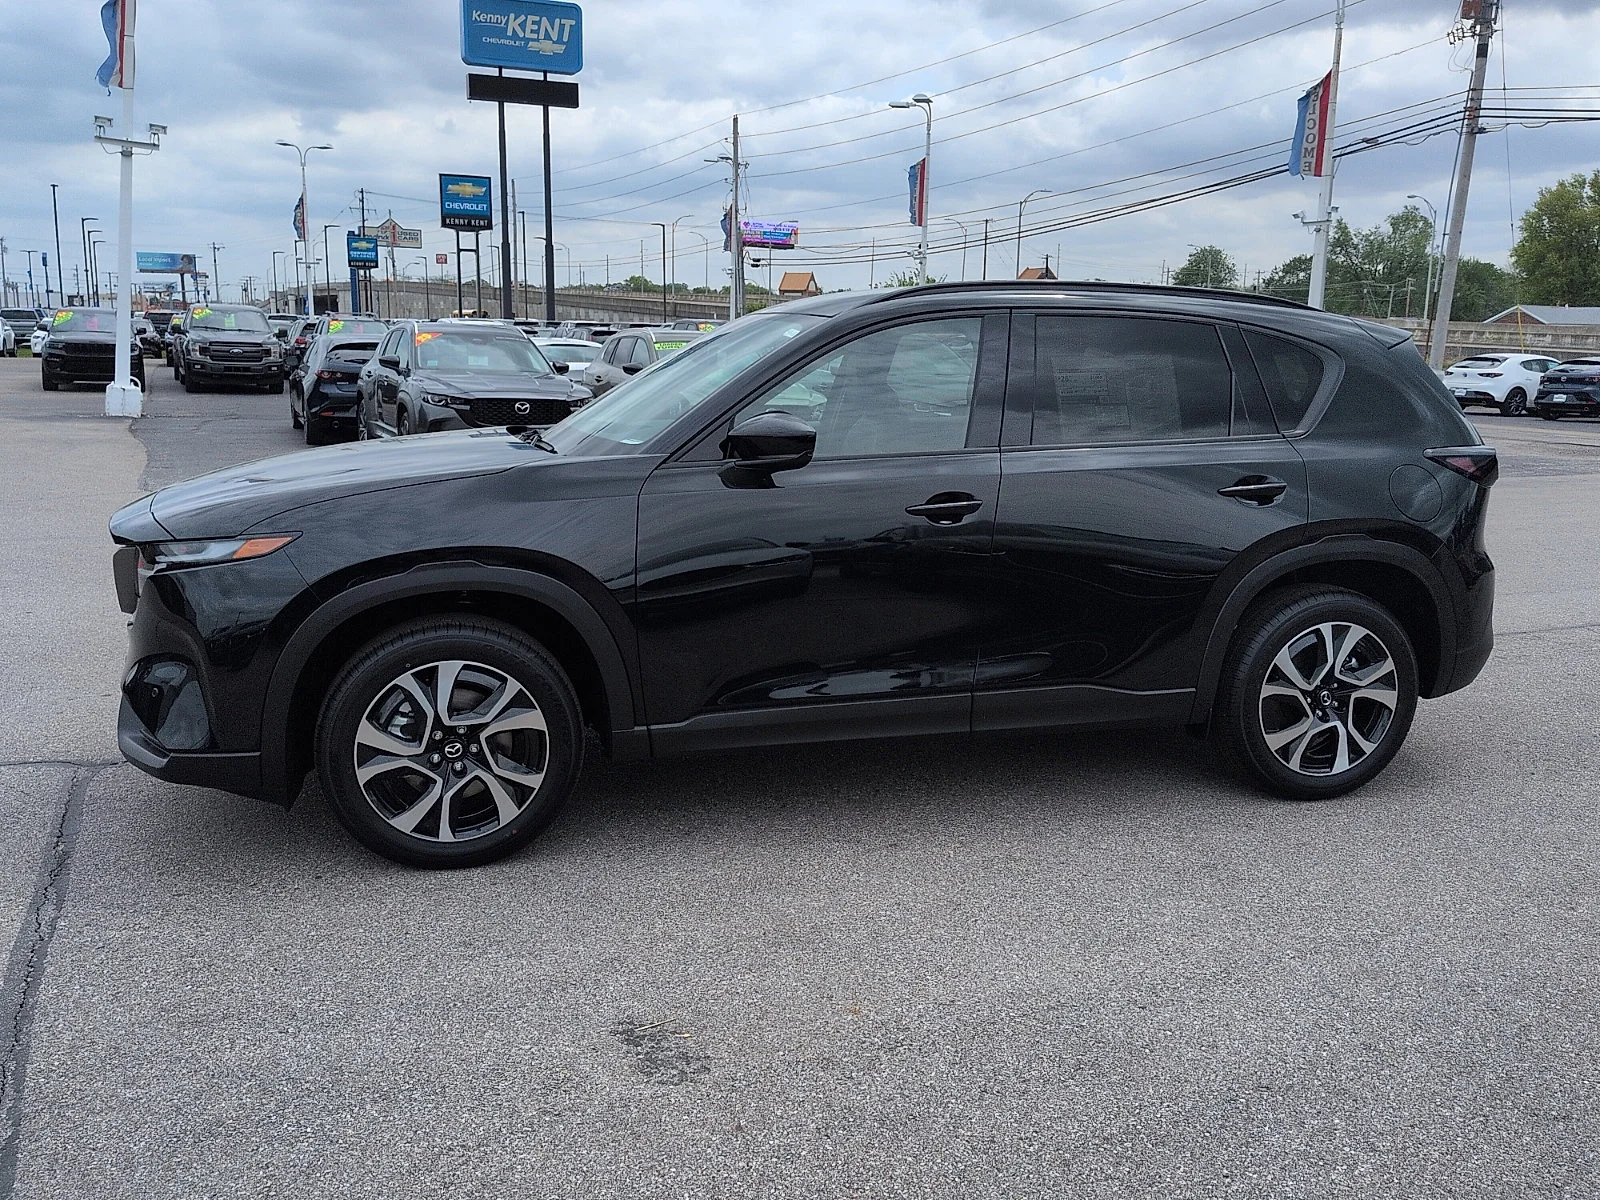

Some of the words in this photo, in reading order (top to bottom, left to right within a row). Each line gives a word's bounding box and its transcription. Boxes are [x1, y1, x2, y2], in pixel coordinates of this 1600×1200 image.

[472, 10, 508, 27] Kenny
[507, 13, 576, 42] KENT
[482, 37, 525, 47] CHEVROLET
[445, 202, 488, 211] CHEVROLET
[445, 218, 469, 226] KENNY
[471, 219, 488, 227] KENT
